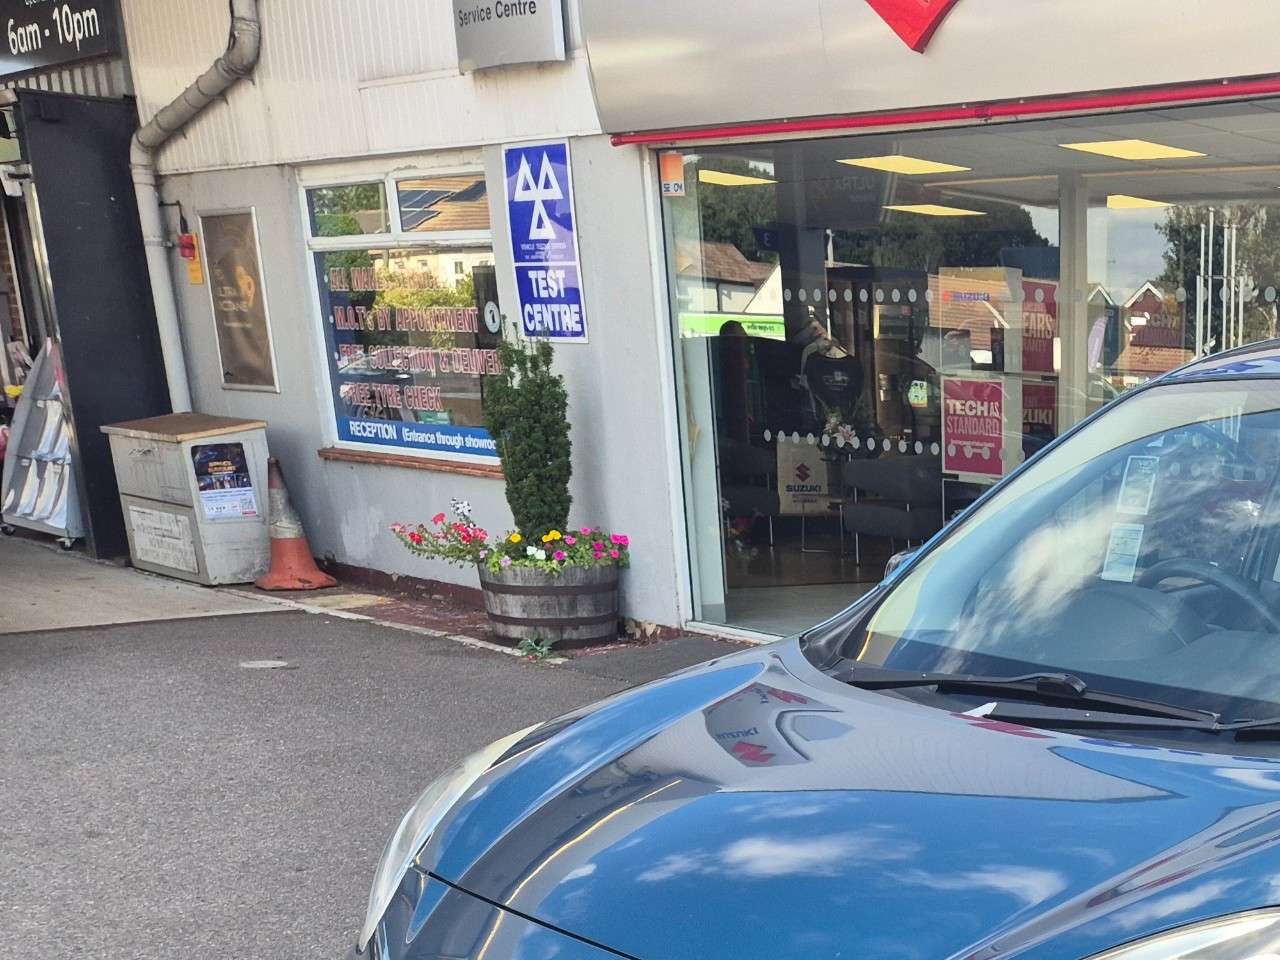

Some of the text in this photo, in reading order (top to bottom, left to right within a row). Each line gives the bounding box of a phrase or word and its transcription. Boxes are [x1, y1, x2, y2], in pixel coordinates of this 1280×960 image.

[458, 0, 537, 27] Service Centre
[7, 18, 42, 55] 6am
[52, 3, 100, 52] 10pm
[527, 270, 566, 298] TEST
[377, 306, 392, 331] BY
[395, 306, 479, 333] APPOINTMENT
[523, 303, 582, 331] CENTRE
[339, 344, 504, 375] FREE COLLECTION & DELIVER
[373, 383, 402, 408] TYRE
[404, 385, 443, 411] CHECK
[946, 399, 1000, 417] TECH AS
[946, 416, 1001, 435] STANDARD
[1023, 408, 1054, 425] ZUKI
[349, 421, 397, 440] RECEPTION
[402, 427, 436, 445] (Entrance
[436, 431, 464, 449] through
[785, 484, 822, 493] SUZUKI
